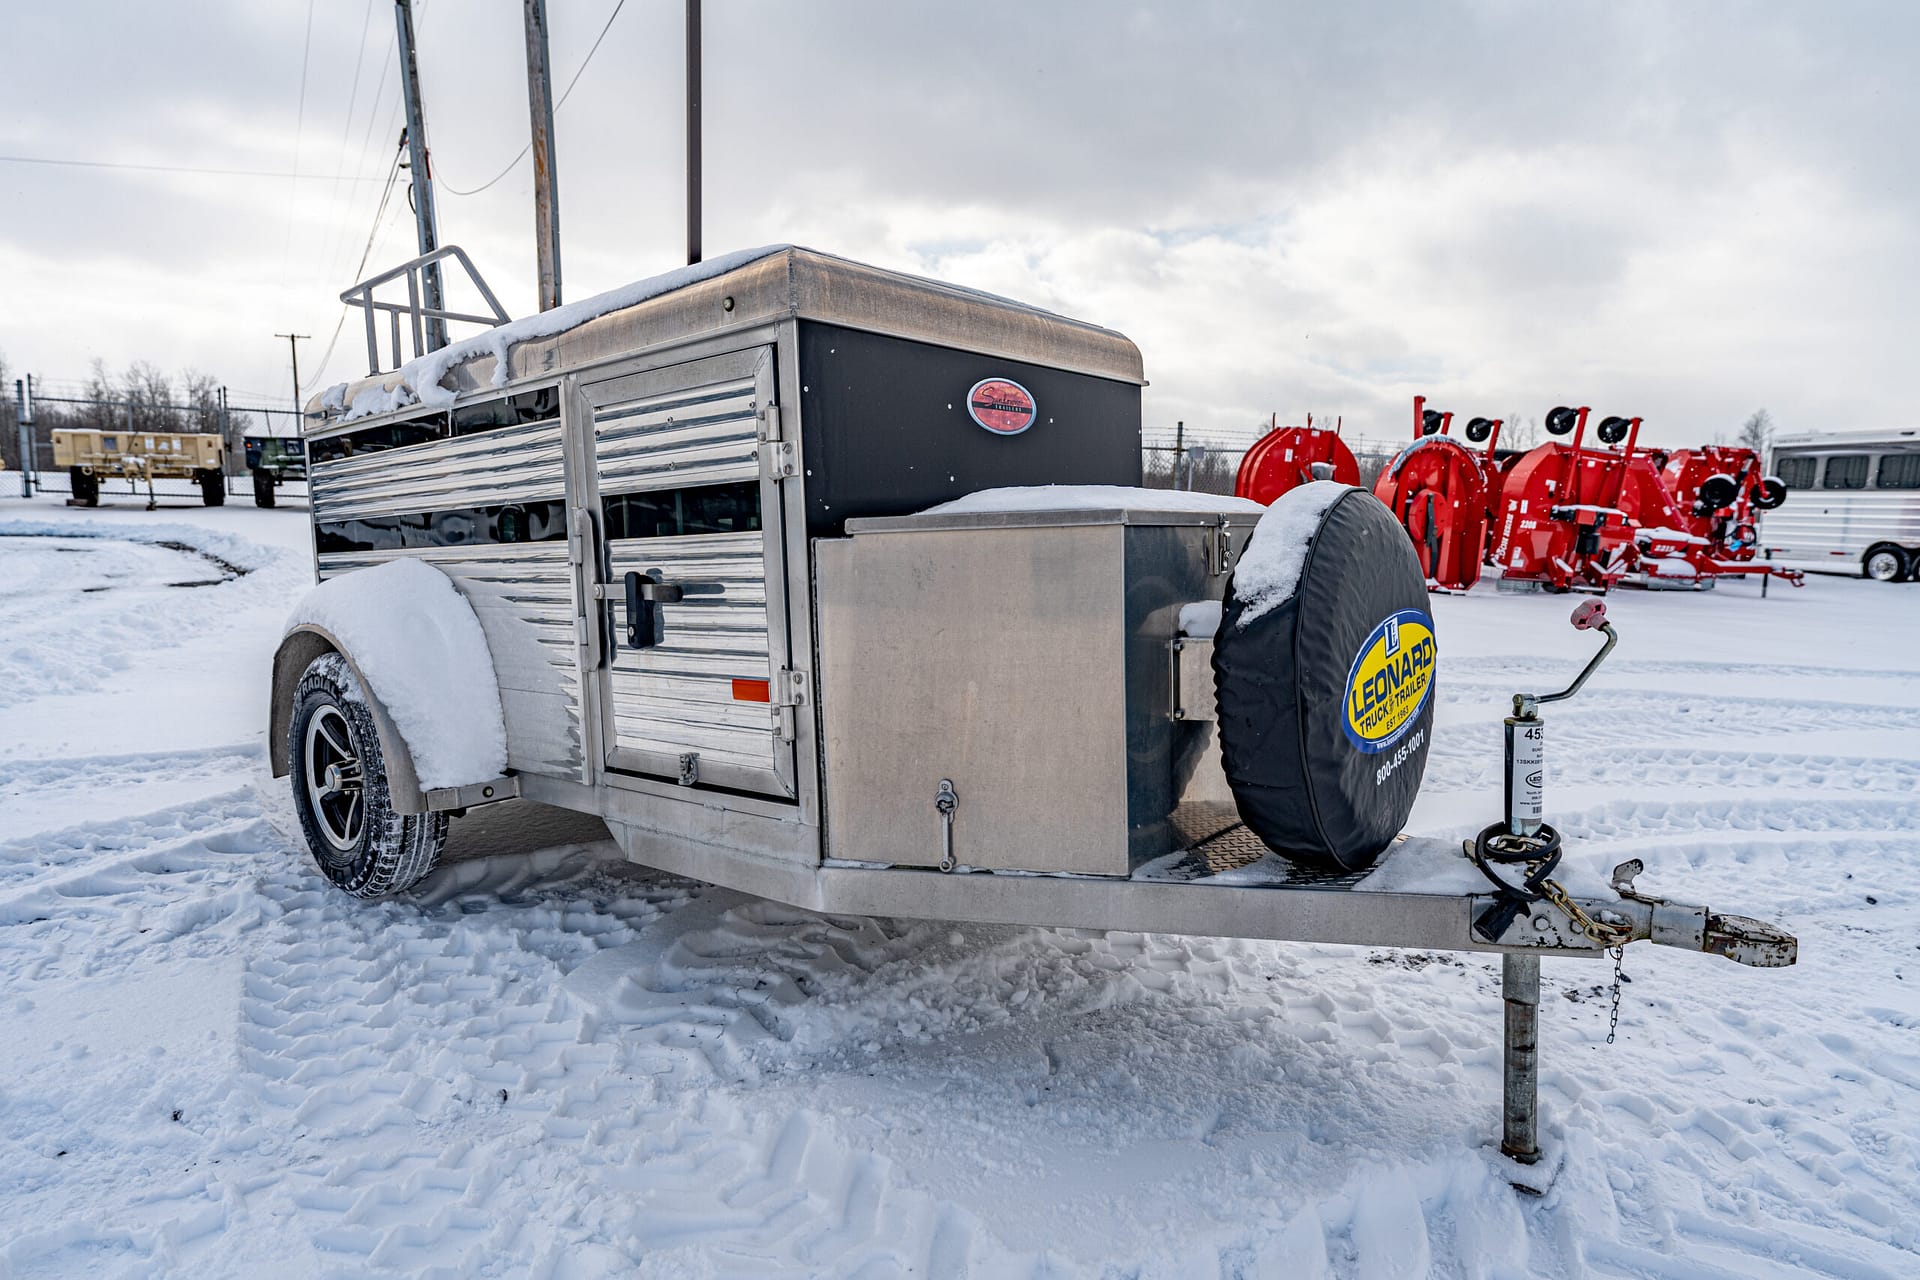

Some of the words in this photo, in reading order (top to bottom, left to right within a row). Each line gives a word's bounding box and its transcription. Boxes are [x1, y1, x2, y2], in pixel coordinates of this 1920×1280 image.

[302, 676, 337, 699] RADIAL
[1351, 636, 1432, 723] LEONARD
[1359, 703, 1389, 736] TRUCK
[1395, 672, 1427, 707] TRAILER
[1376, 728, 1424, 786] 800-455-1001
